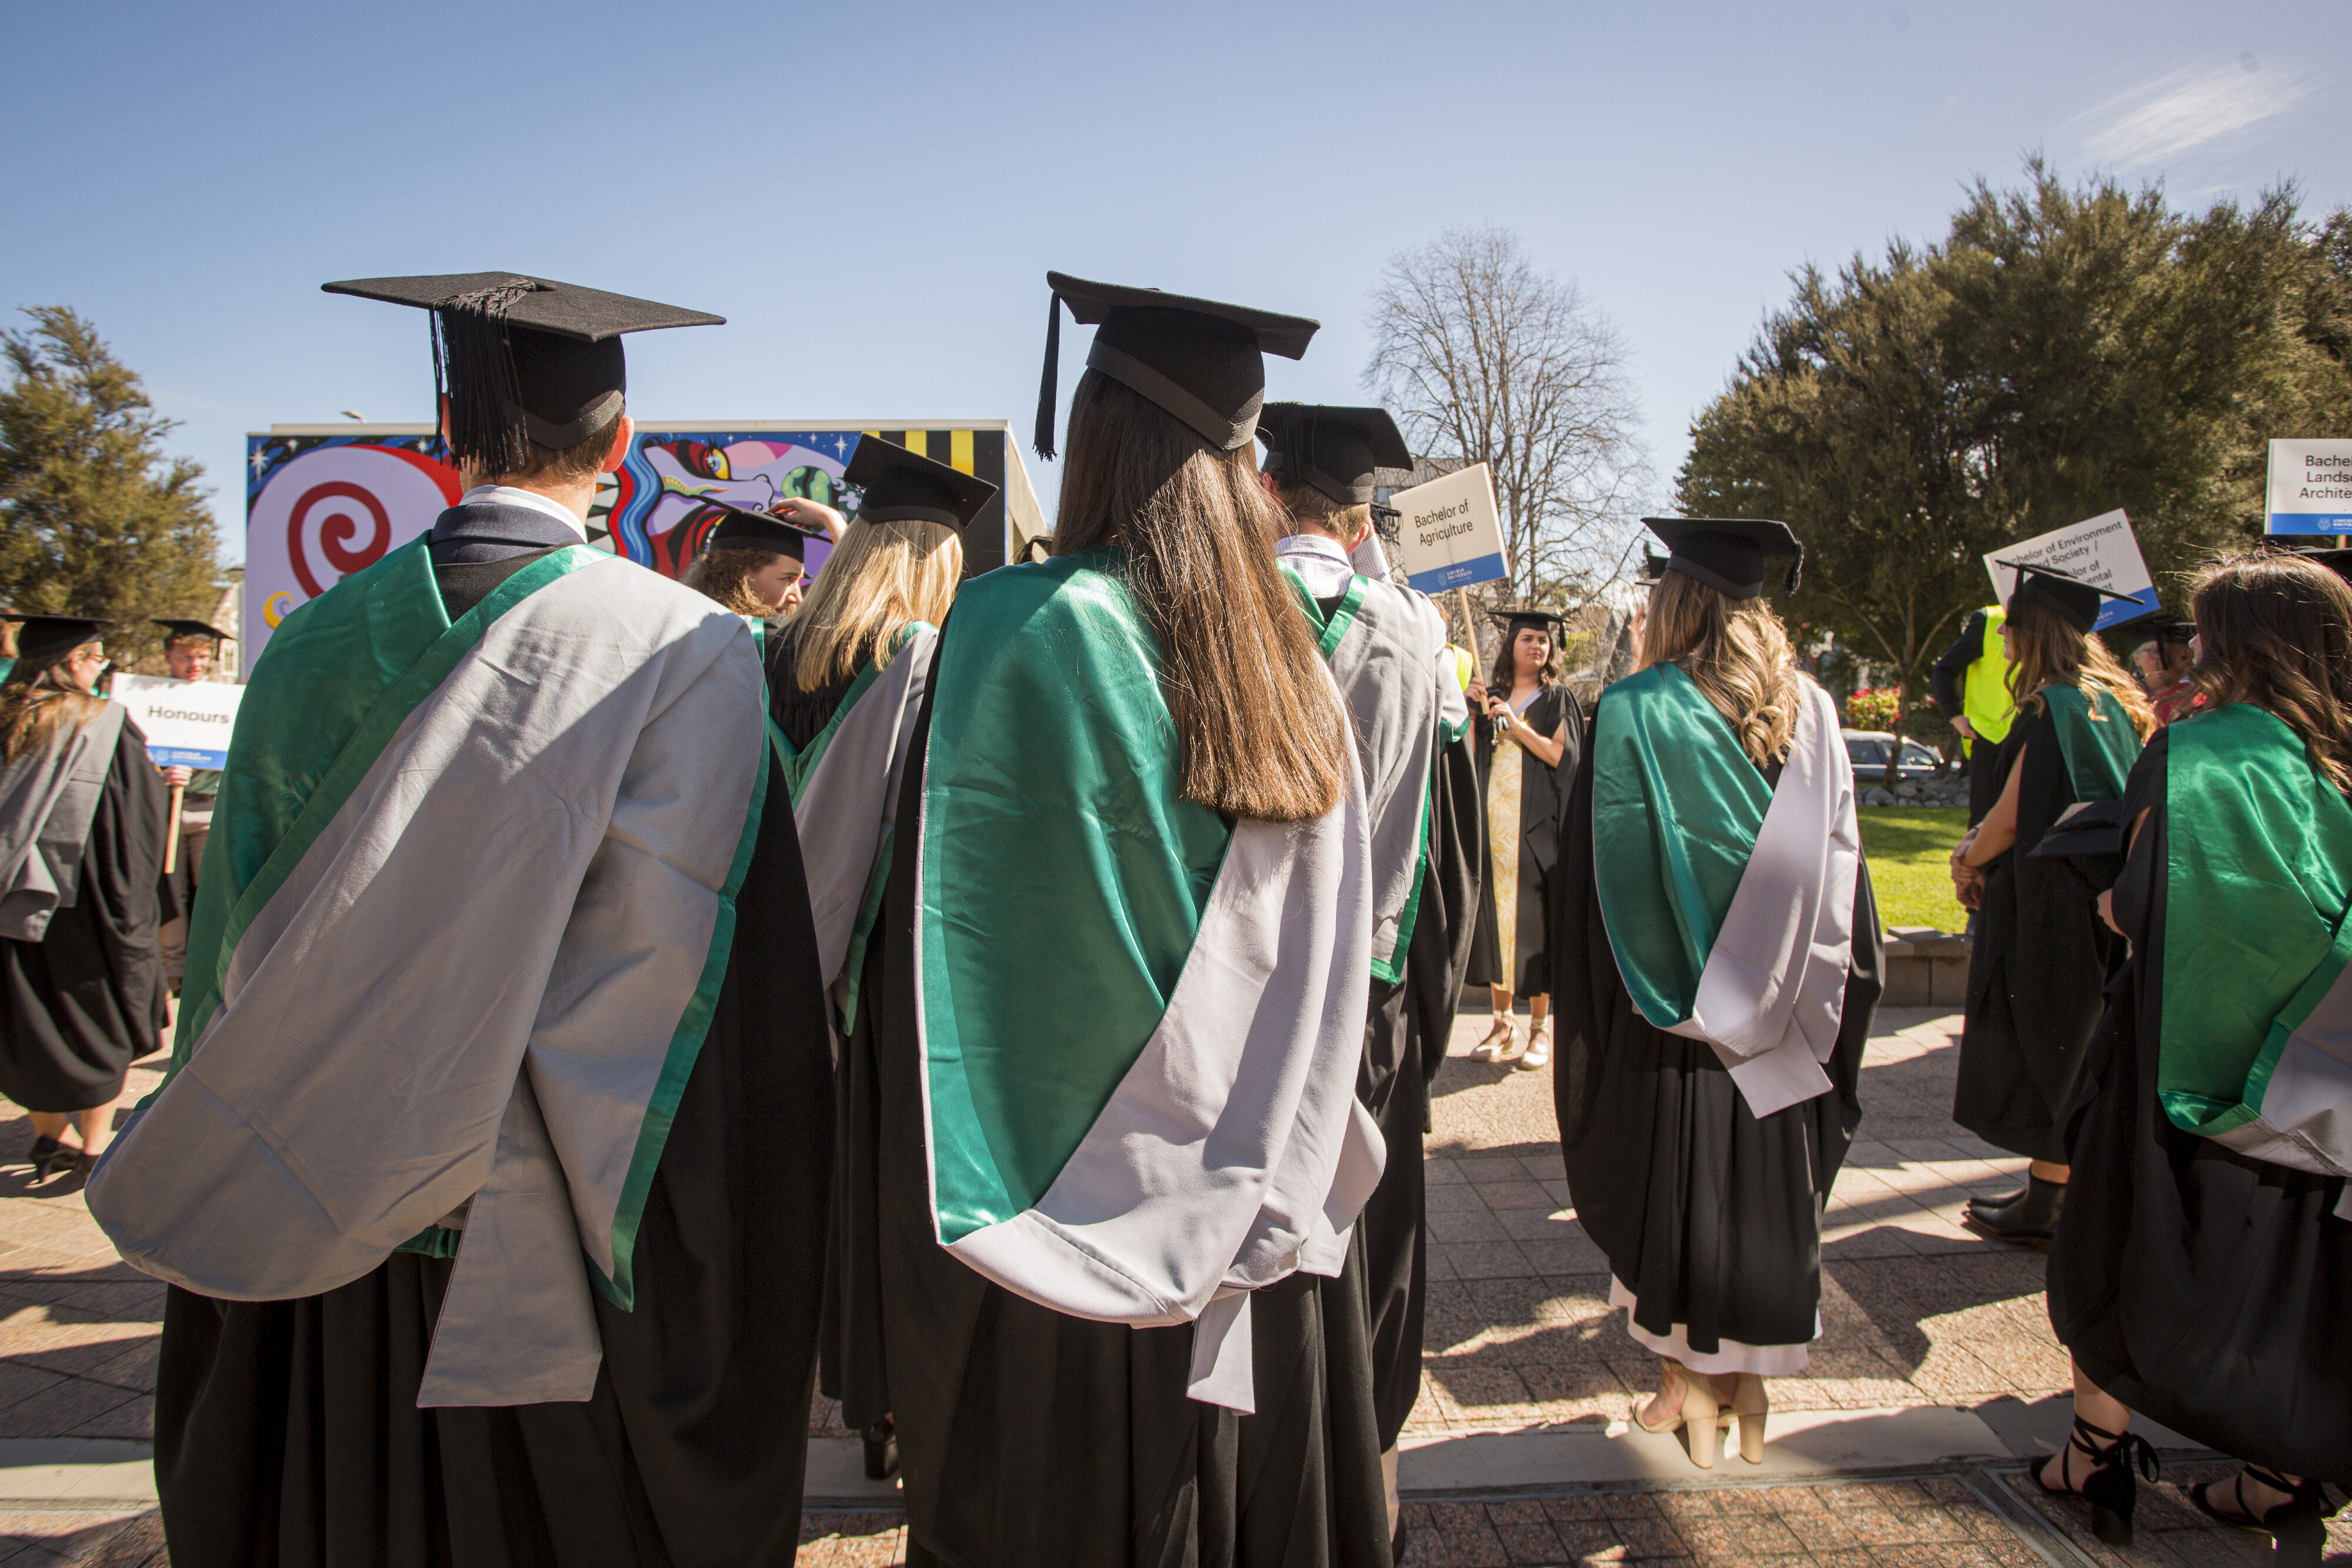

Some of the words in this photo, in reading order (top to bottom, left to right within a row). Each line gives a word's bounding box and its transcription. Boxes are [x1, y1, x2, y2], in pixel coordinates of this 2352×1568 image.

[2305, 455, 2352, 466] Bache
[2306, 471, 2352, 482] Lands
[1414, 506, 1456, 528] Bachelor
[1459, 498, 1469, 513] of
[1420, 521, 1473, 546] Agriculture
[1999, 548, 2043, 571] chelor
[2045, 542, 2056, 553] of
[2058, 521, 2123, 550] Environment
[2051, 545, 2090, 564] Society
[2089, 559, 2100, 571] of
[147, 705, 230, 724] Honours
